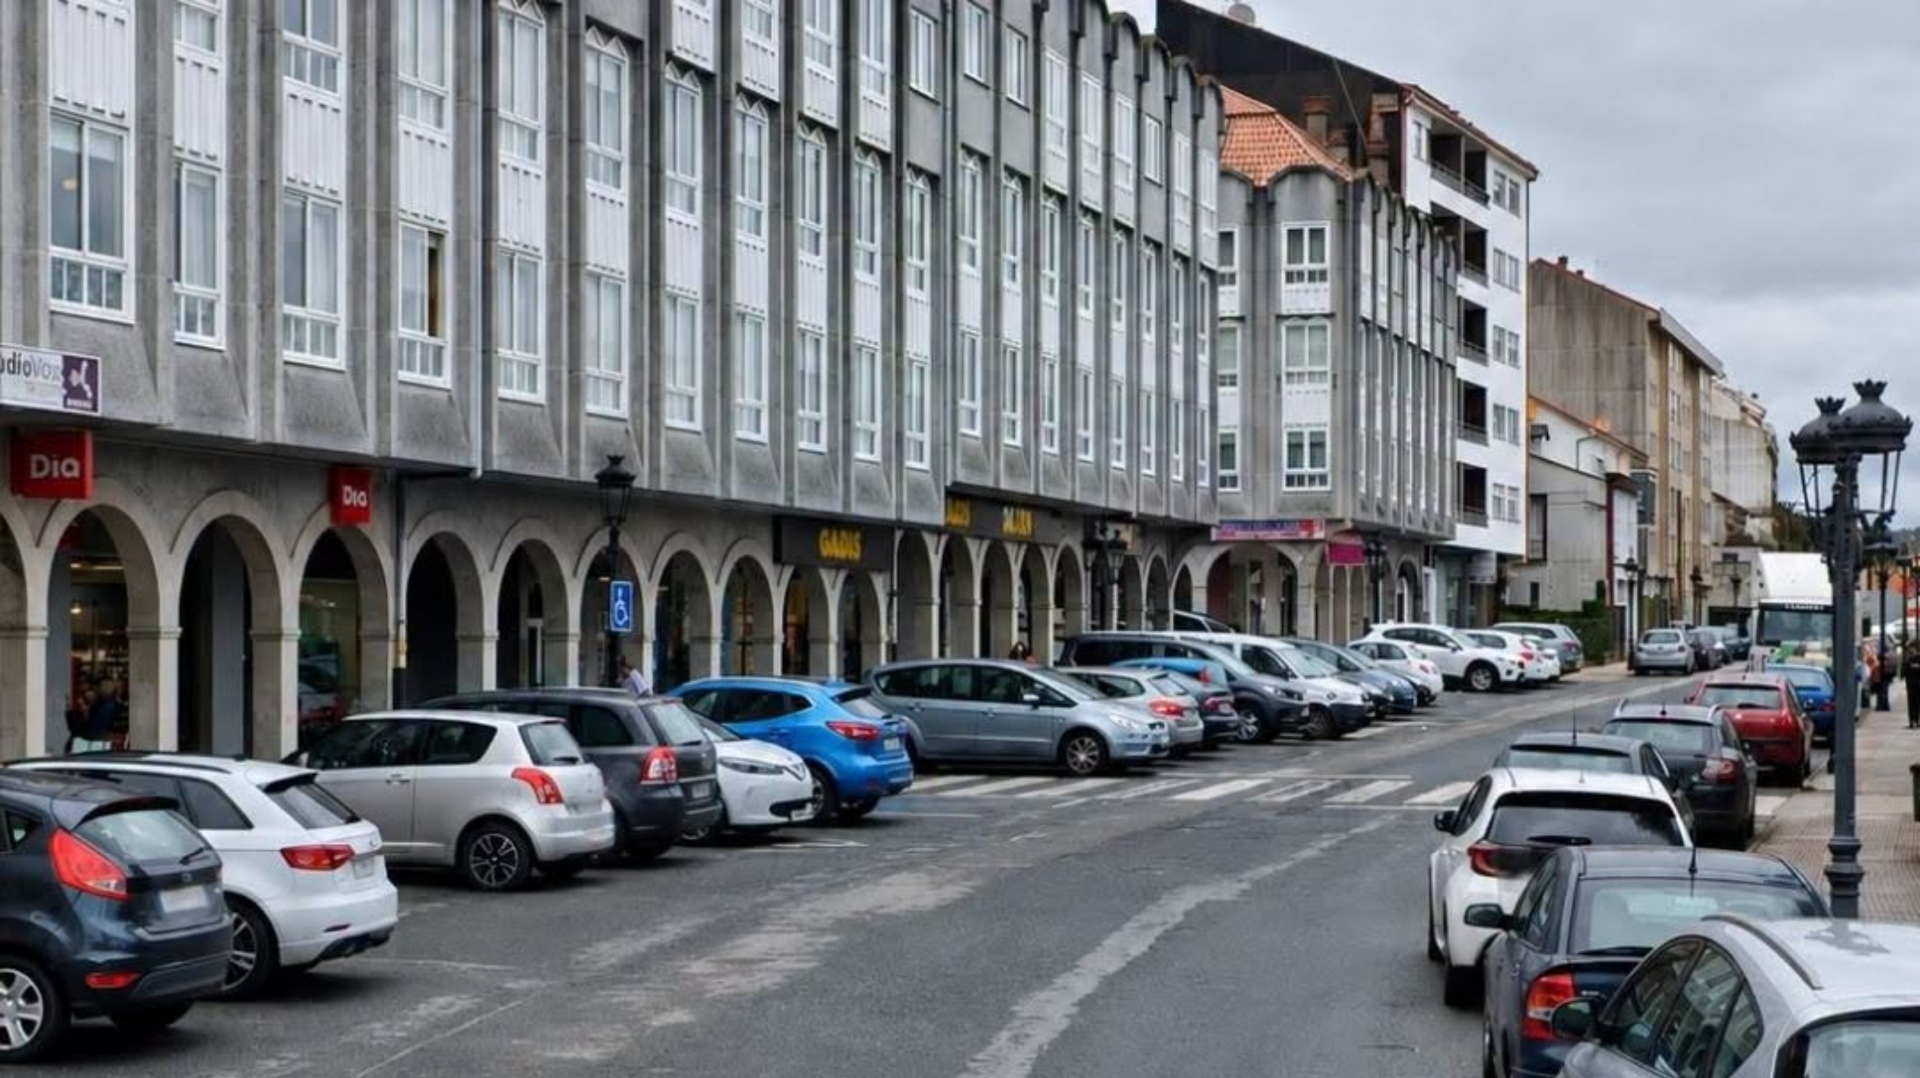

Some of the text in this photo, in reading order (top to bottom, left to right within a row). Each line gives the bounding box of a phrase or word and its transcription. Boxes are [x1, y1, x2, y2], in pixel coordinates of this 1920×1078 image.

[30, 454, 80, 479] Dia
[342, 485, 368, 508] Dia
[819, 527, 862, 561] GADIS
